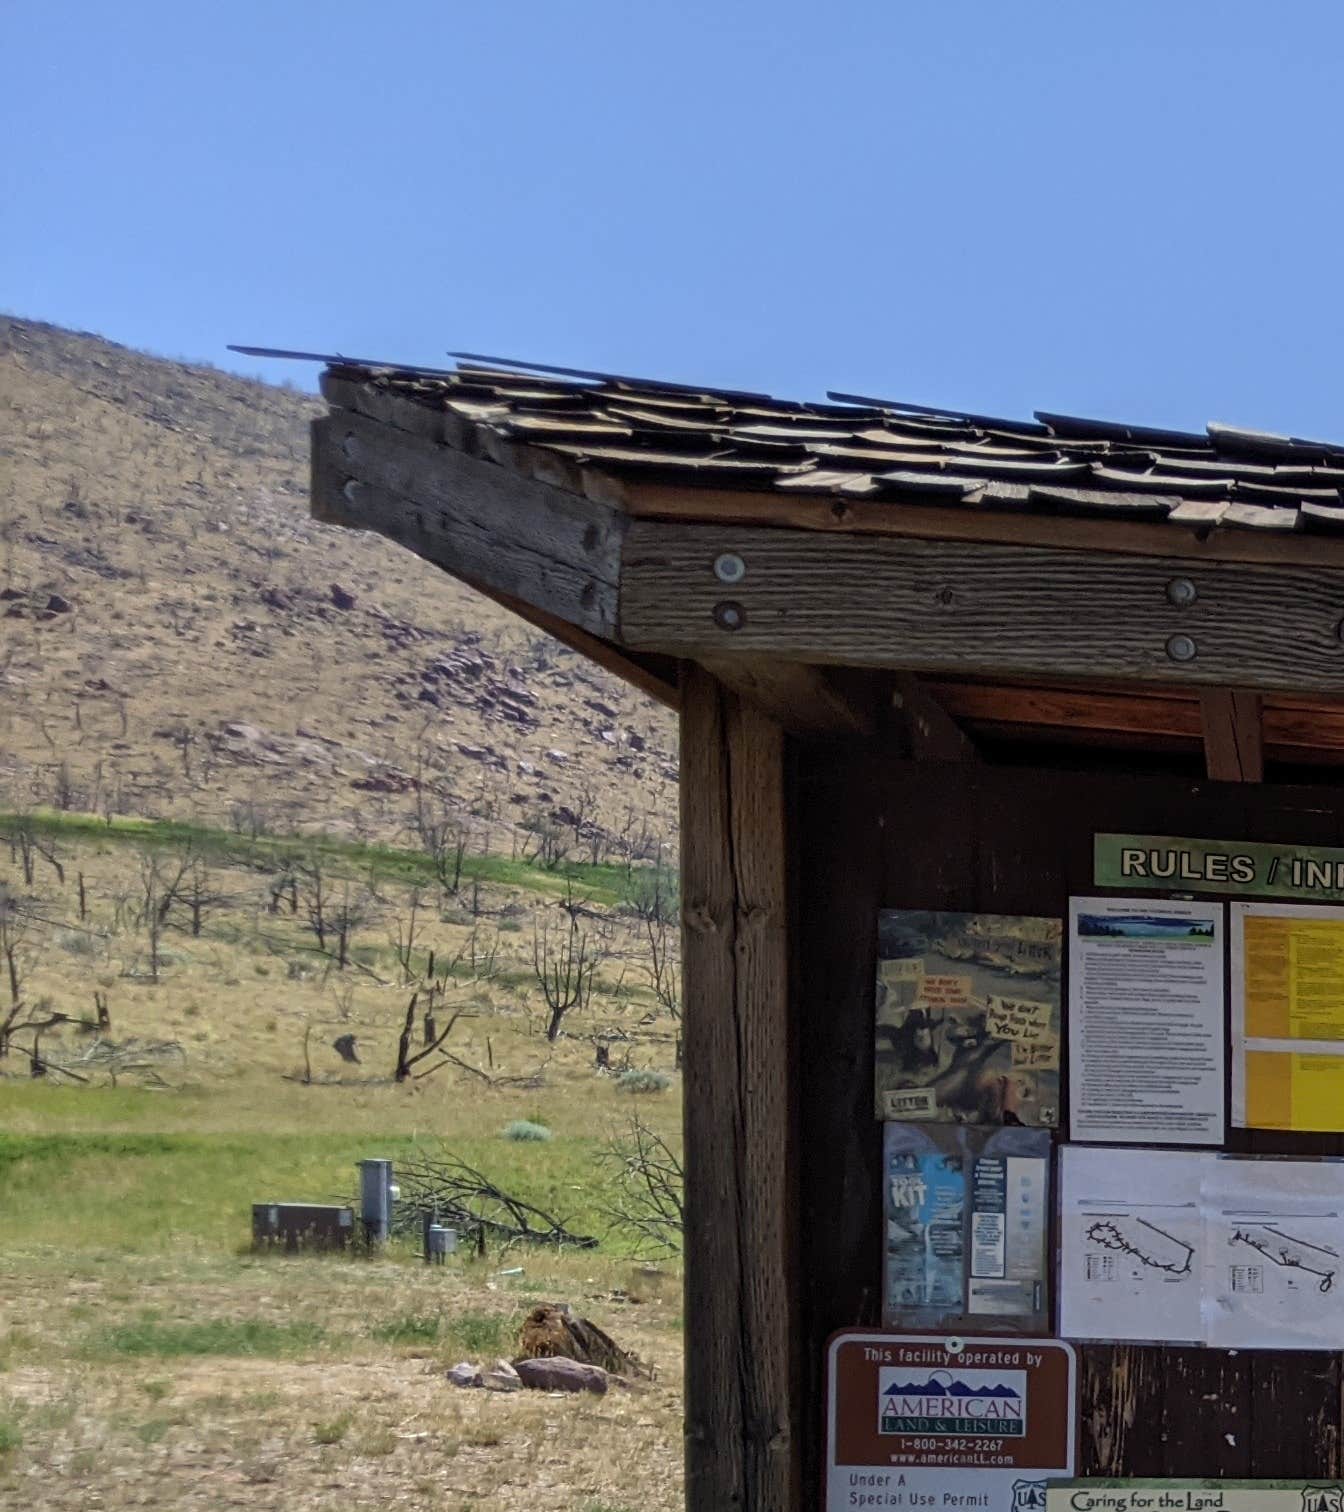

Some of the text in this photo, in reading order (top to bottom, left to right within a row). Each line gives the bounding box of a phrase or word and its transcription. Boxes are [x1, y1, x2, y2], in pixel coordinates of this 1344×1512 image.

[1121, 848, 1255, 883] RULES
[1267, 857, 1278, 885] /
[892, 1185, 927, 1208] KIT
[864, 1347, 1043, 1367] This facility operated by
[882, 1398, 1021, 1418] AMERICAN
[884, 1418, 1018, 1433] LAND & LEISURE
[901, 1439, 1003, 1451] 1-800-342-2267
[889, 1454, 1014, 1465] www.americanLL.com
[850, 1474, 906, 1486] Under A
[850, 1491, 989, 1507] Special Use Permit
[1070, 1491, 1224, 1512] Caring for the Land
